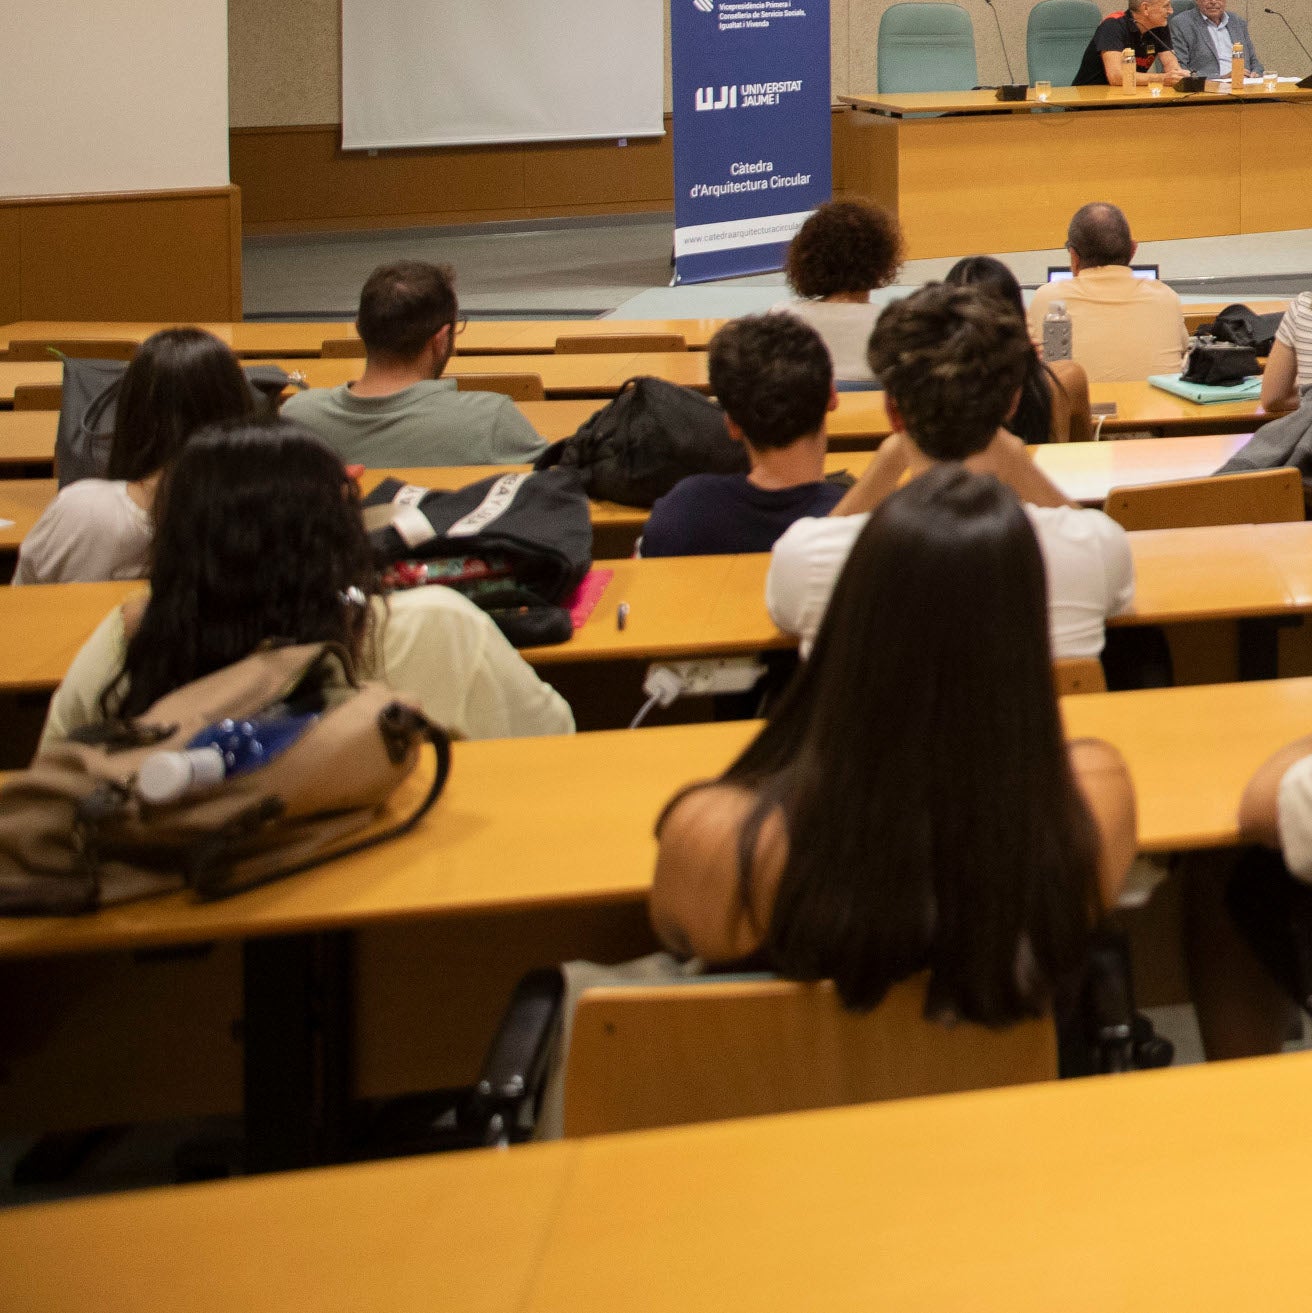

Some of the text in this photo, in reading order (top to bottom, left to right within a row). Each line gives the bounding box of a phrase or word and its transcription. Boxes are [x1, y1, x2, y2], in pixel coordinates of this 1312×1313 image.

[765, 0, 788, 10] Primera
[719, 11, 752, 21] Conselleria
[752, 10, 760, 19] de
[719, 20, 742, 31] Igualtat
[746, 19, 769, 29] Vivenda
[741, 79, 803, 96] UNIVERSITAT
[695, 85, 737, 111] UJI
[741, 93, 776, 108] JAUME
[730, 159, 774, 176] Càtedra
[770, 172, 811, 188] Circular
